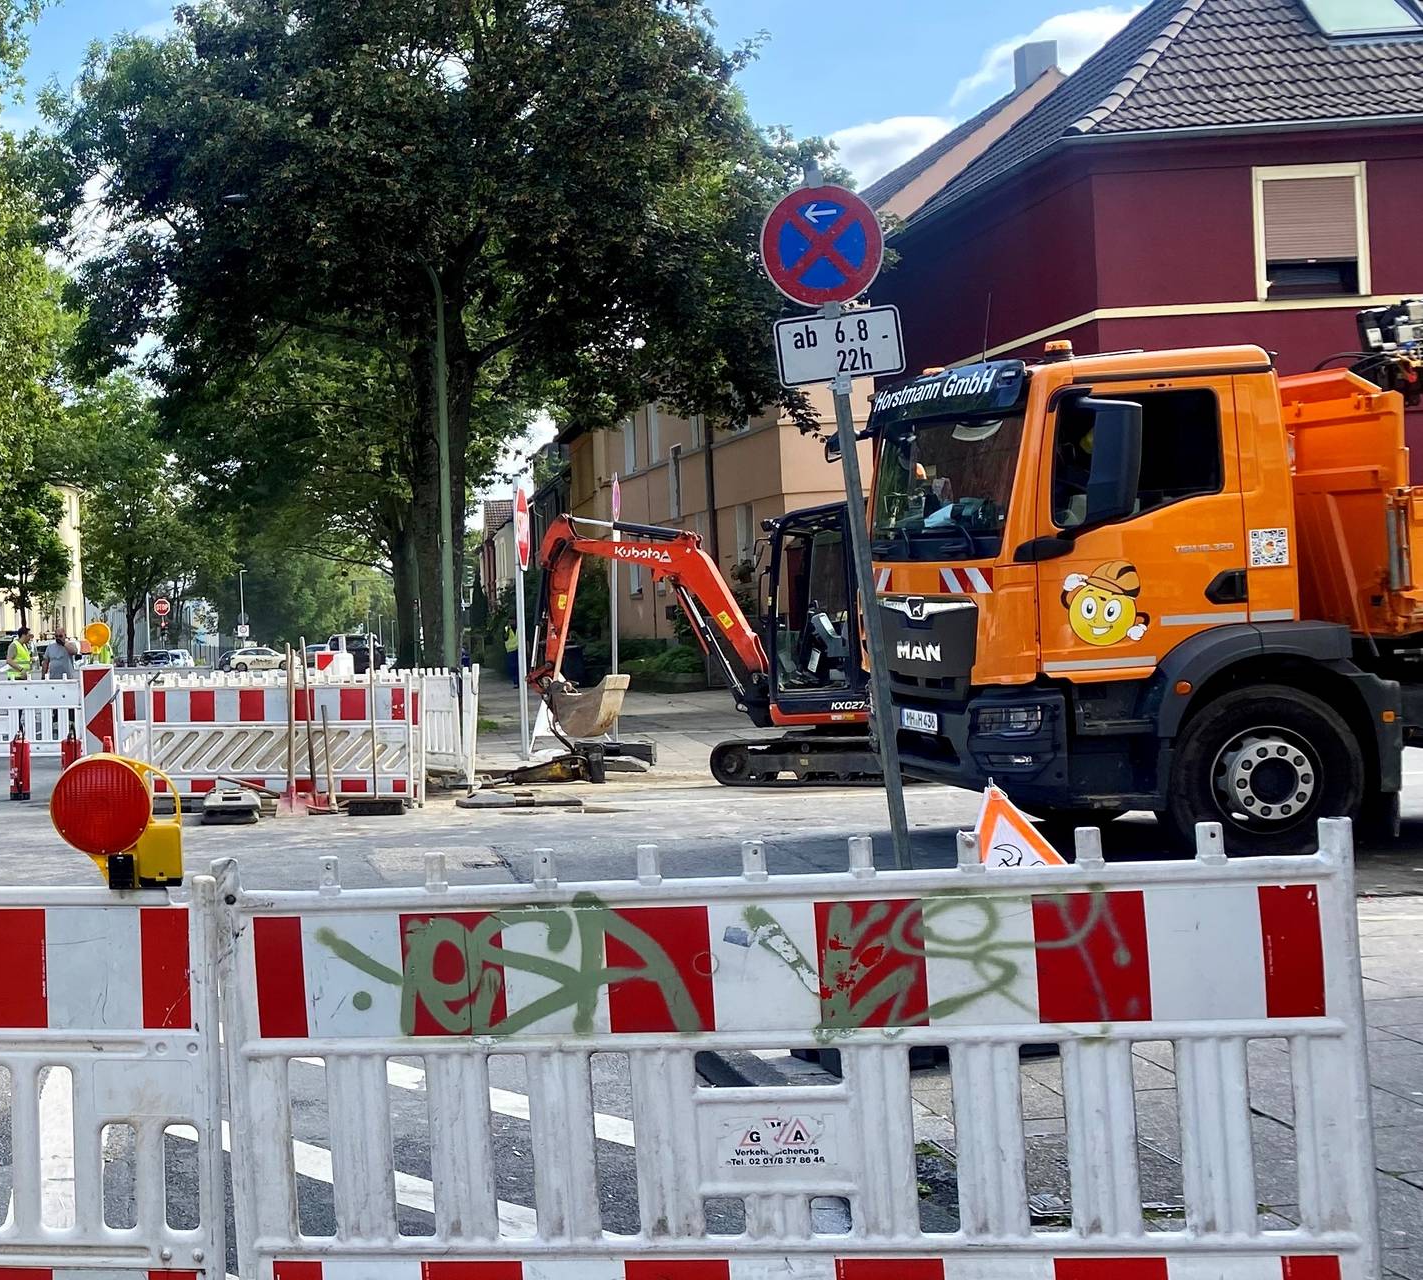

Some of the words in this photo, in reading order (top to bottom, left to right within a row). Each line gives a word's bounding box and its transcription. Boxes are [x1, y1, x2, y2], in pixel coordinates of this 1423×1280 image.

[793, 324, 818, 350] ab
[835, 318, 869, 345] 6.8
[836, 347, 873, 373] 22h
[873, 381, 940, 413] Horstmann
[942, 368, 998, 398] GmbH
[614, 545, 661, 560] Kubota
[156, 603, 168, 611] STOP
[897, 640, 941, 662] MAN
[749, 1157, 760, 1165] 02
